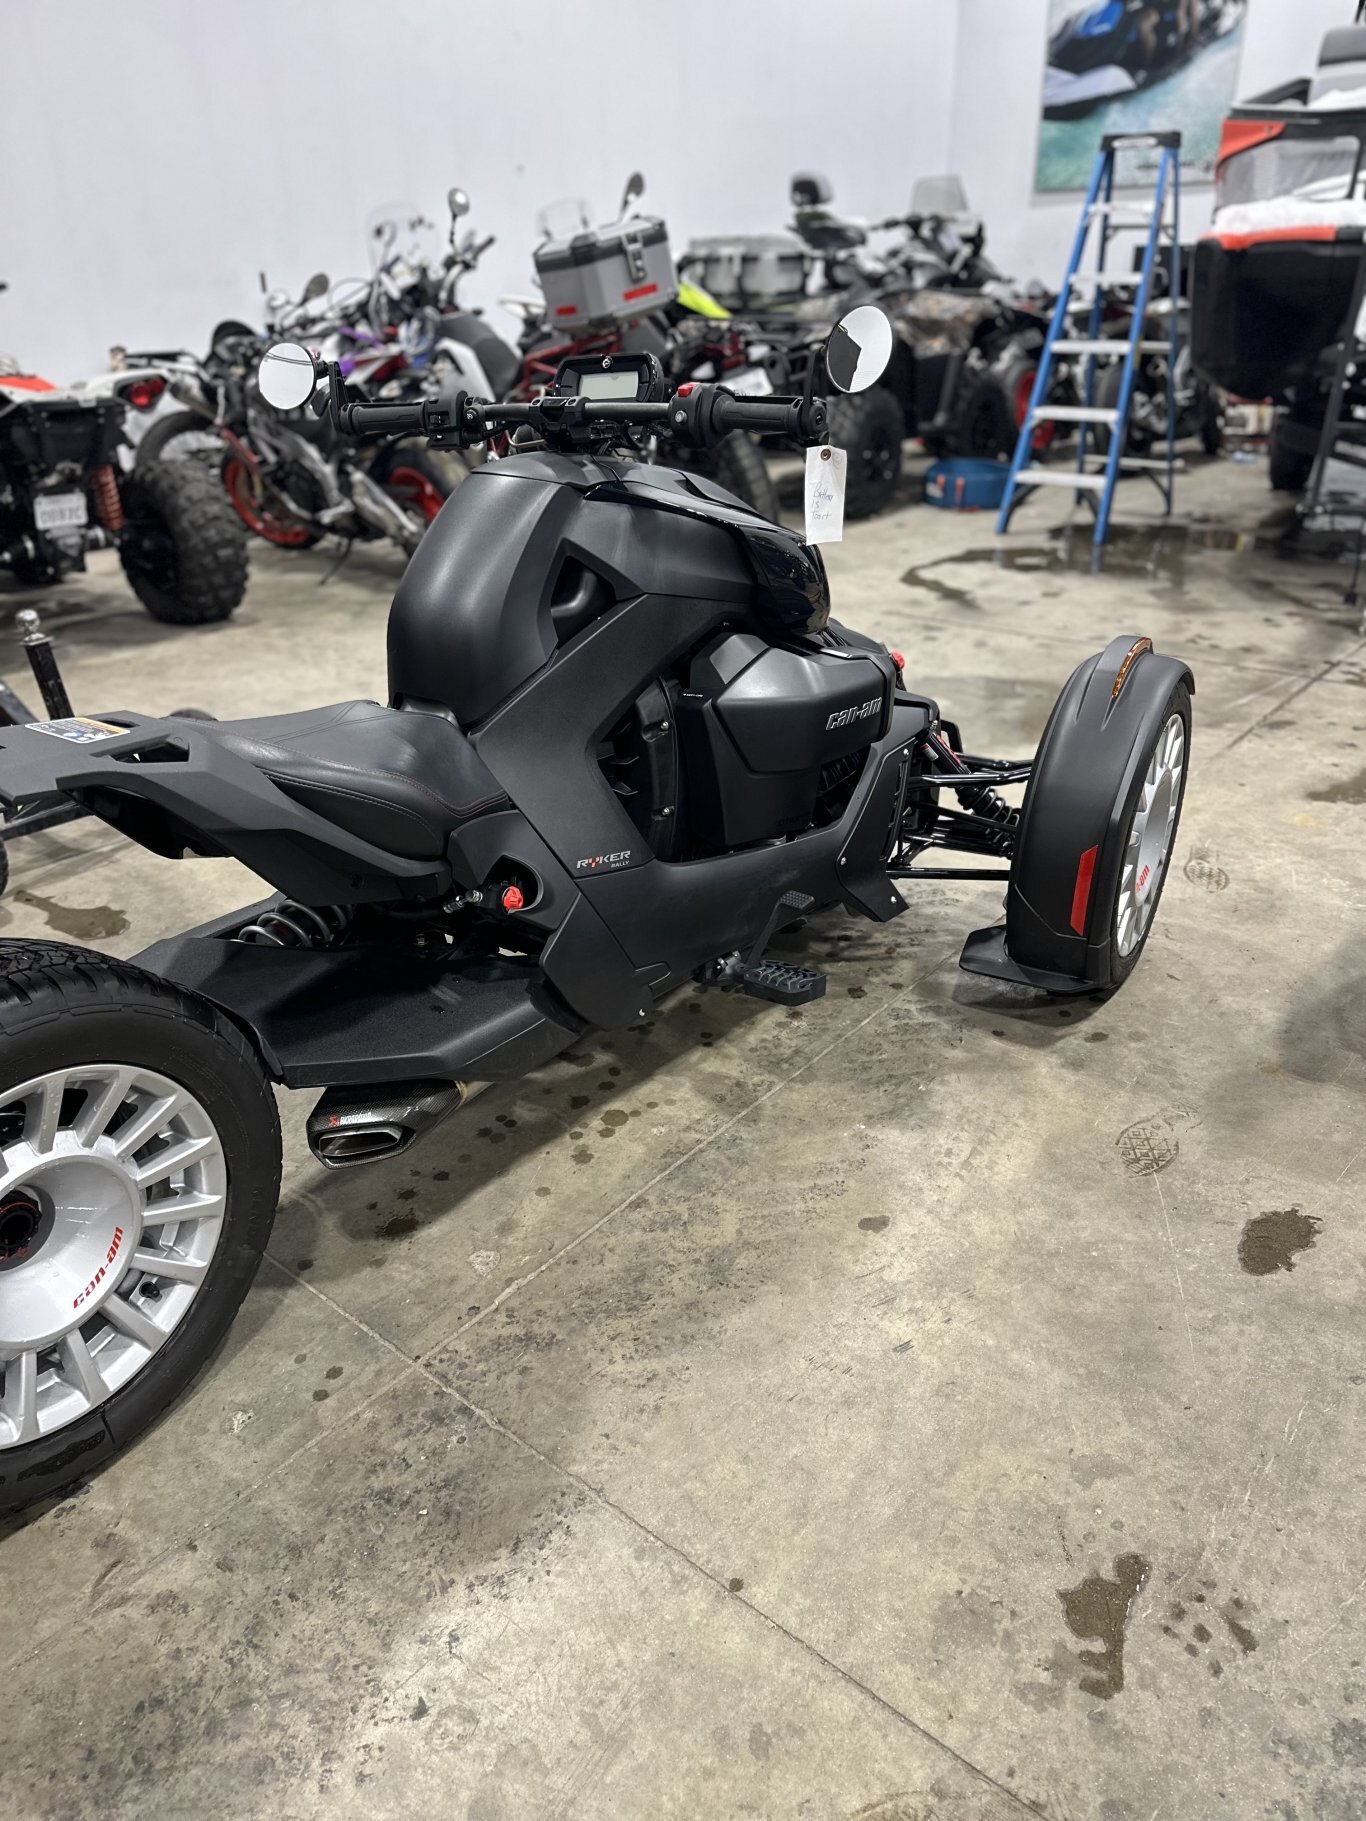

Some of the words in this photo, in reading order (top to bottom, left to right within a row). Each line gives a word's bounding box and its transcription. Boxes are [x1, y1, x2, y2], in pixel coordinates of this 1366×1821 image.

[825, 696, 883, 731] can-am
[576, 850, 631, 869] RYKER
[611, 860, 630, 869] RALLY
[73, 1226, 124, 1309] can-am
